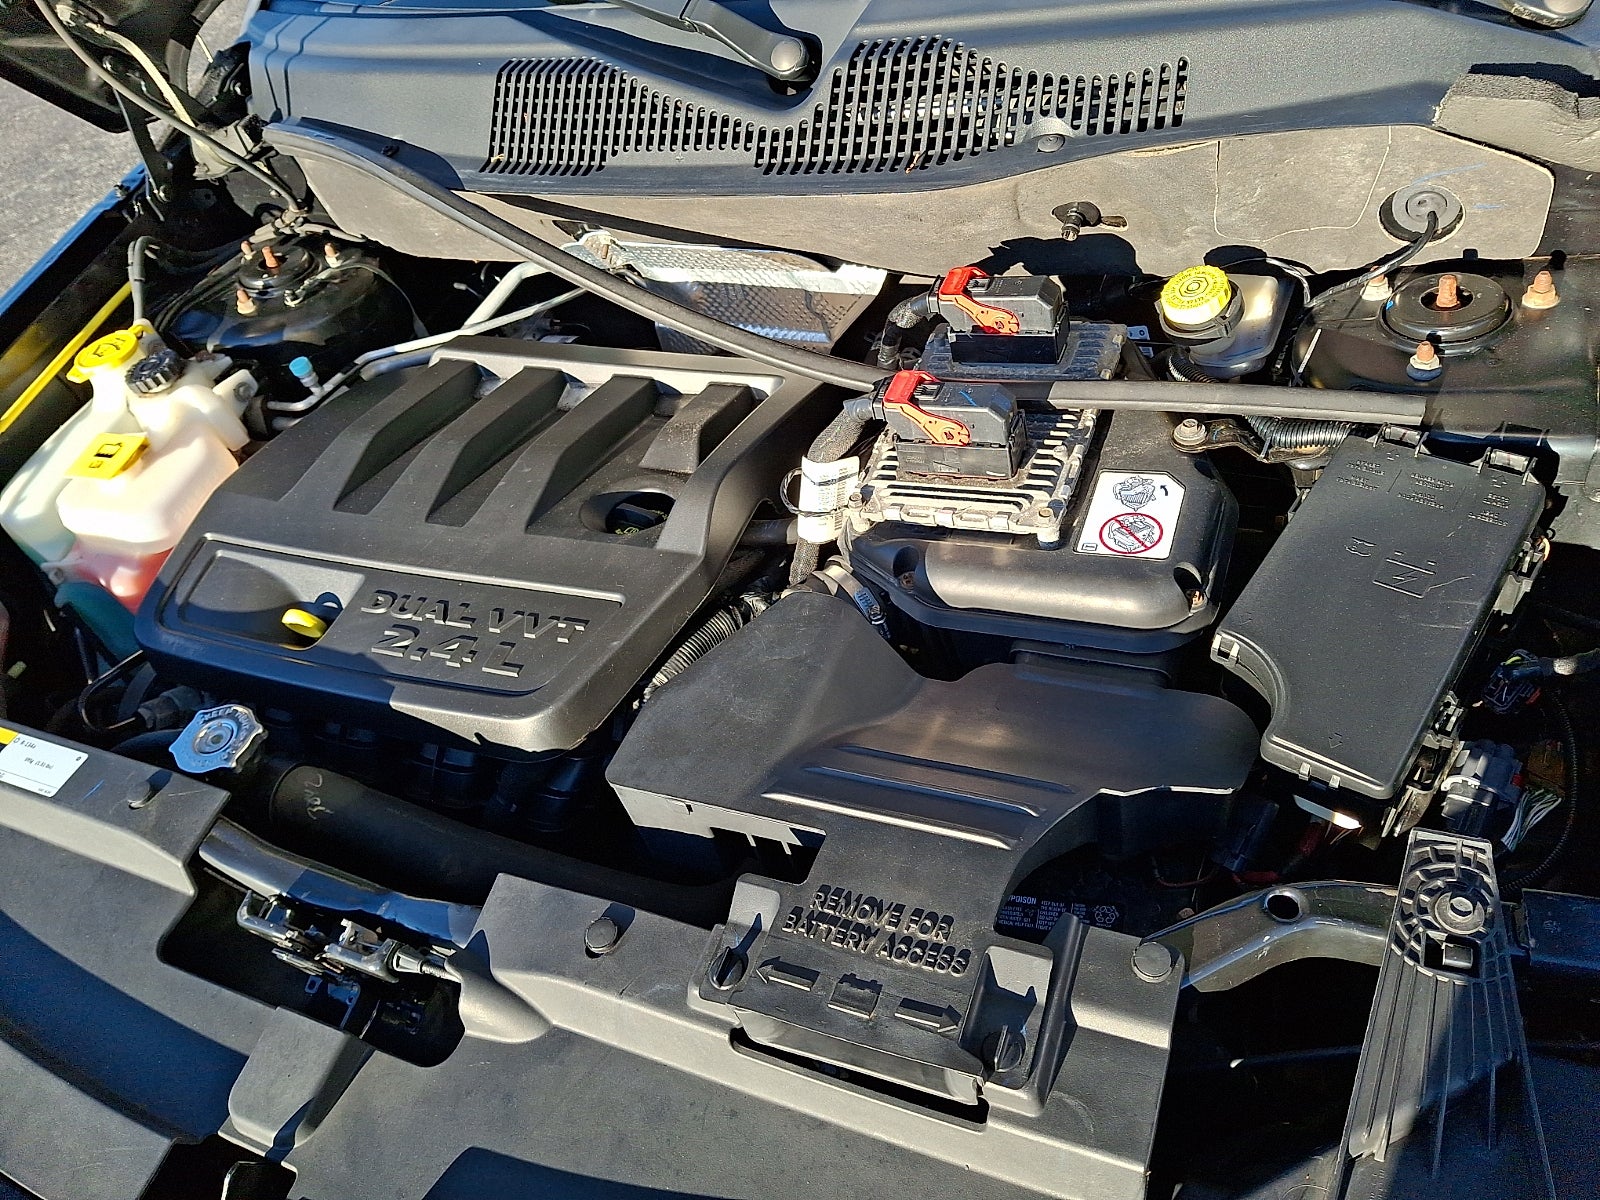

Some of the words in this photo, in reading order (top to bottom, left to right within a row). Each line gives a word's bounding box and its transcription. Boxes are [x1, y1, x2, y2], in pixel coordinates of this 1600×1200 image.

[361, 588, 477, 630] DUAL
[488, 607, 591, 644] VVT
[782, 907, 879, 954] BATTERY
[876, 934, 972, 978] ACCESS
[810, 885, 905, 931] REMOVE
[904, 908, 955, 943] FOR
